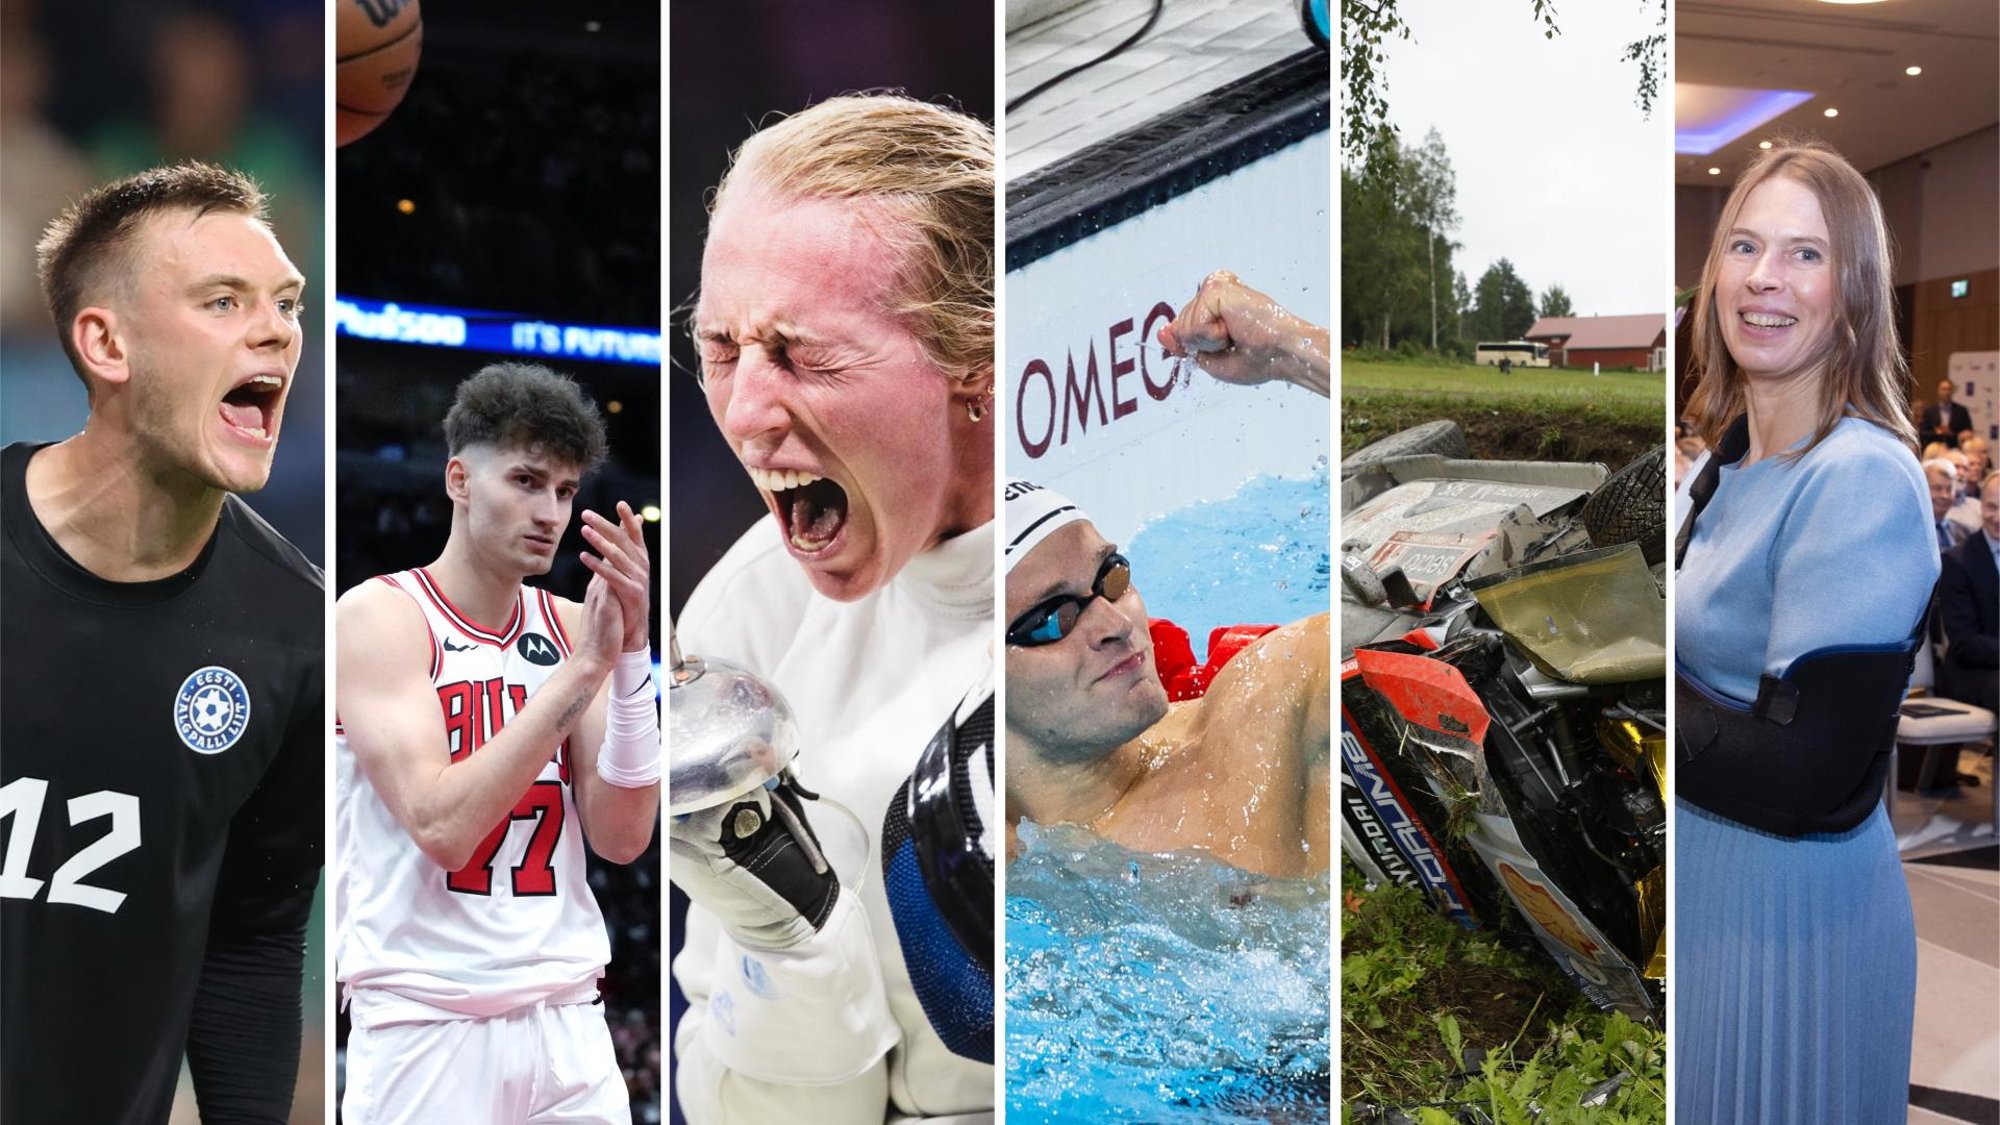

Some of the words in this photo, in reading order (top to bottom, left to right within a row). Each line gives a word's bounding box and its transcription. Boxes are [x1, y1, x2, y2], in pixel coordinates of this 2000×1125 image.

[1016, 301, 1184, 459] OMEG
[196, 672, 237, 692] EESTI
[0, 777, 142, 914] 12
